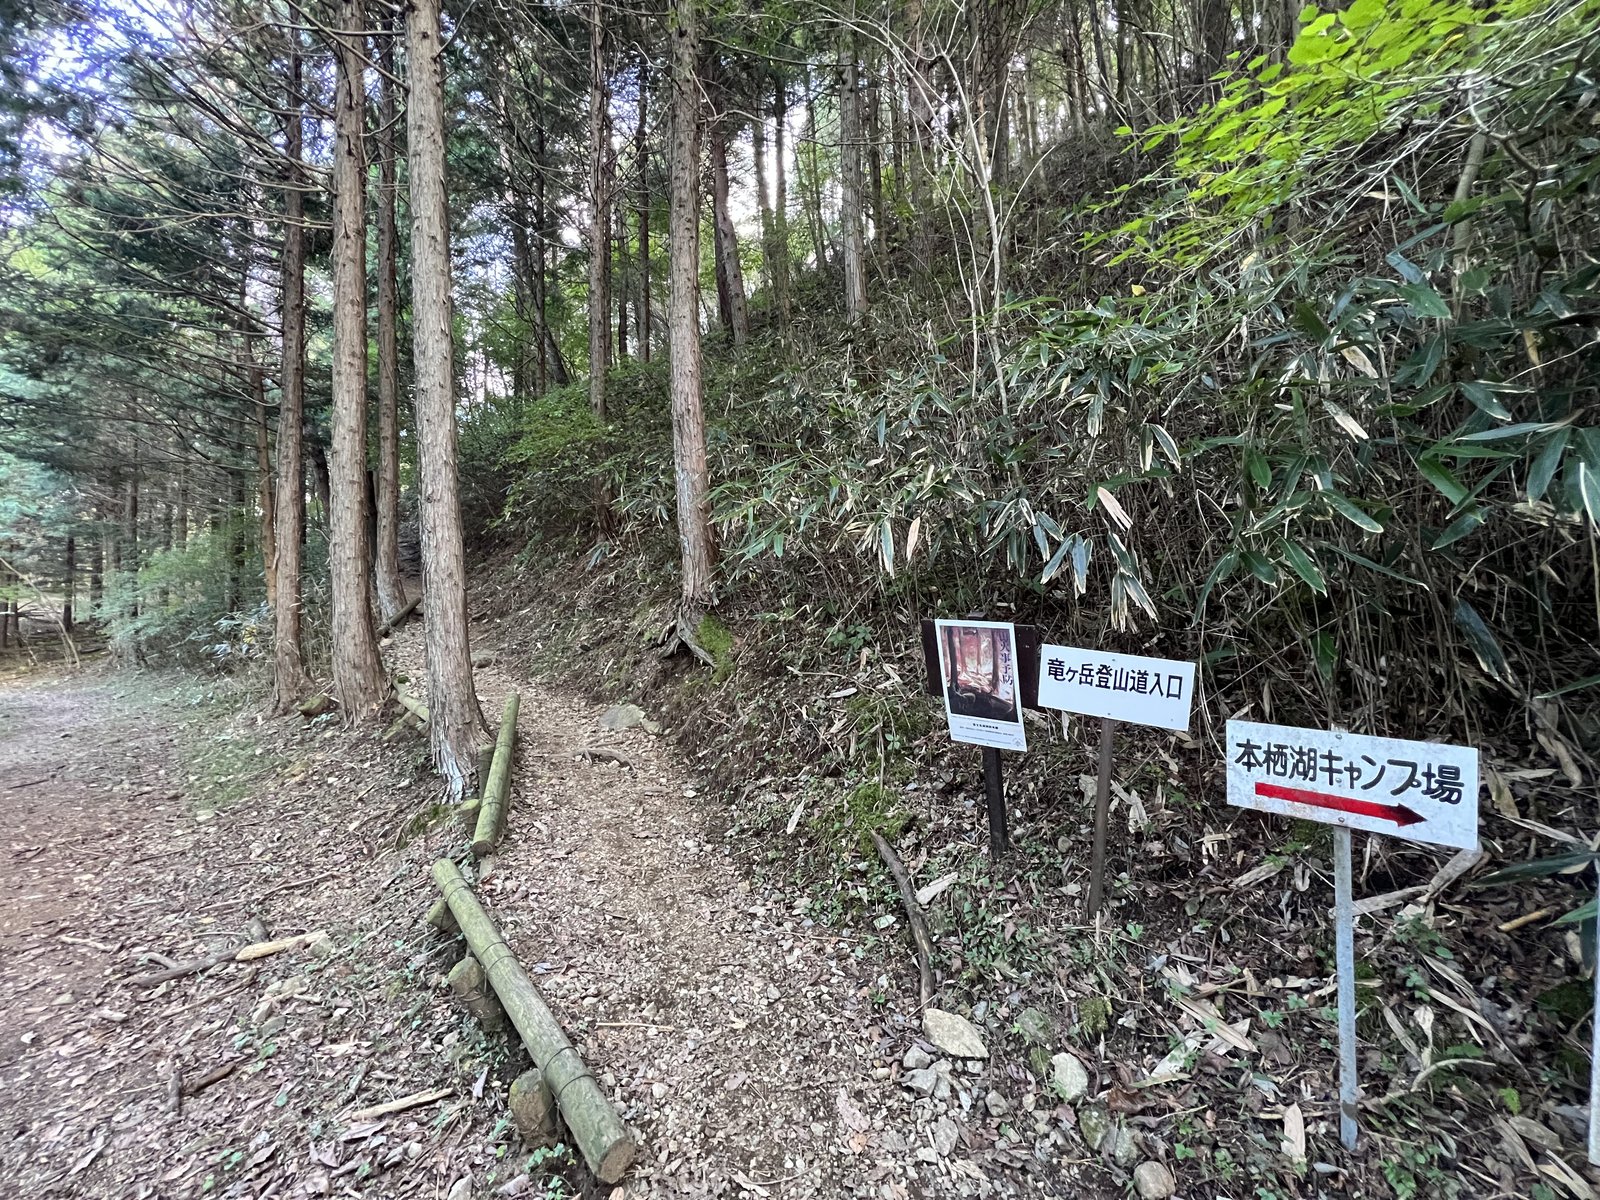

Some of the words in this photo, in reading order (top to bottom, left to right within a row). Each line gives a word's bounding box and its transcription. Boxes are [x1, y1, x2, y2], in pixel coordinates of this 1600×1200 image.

[1234, 739, 1465, 804] 本栖湖キャンプ場
